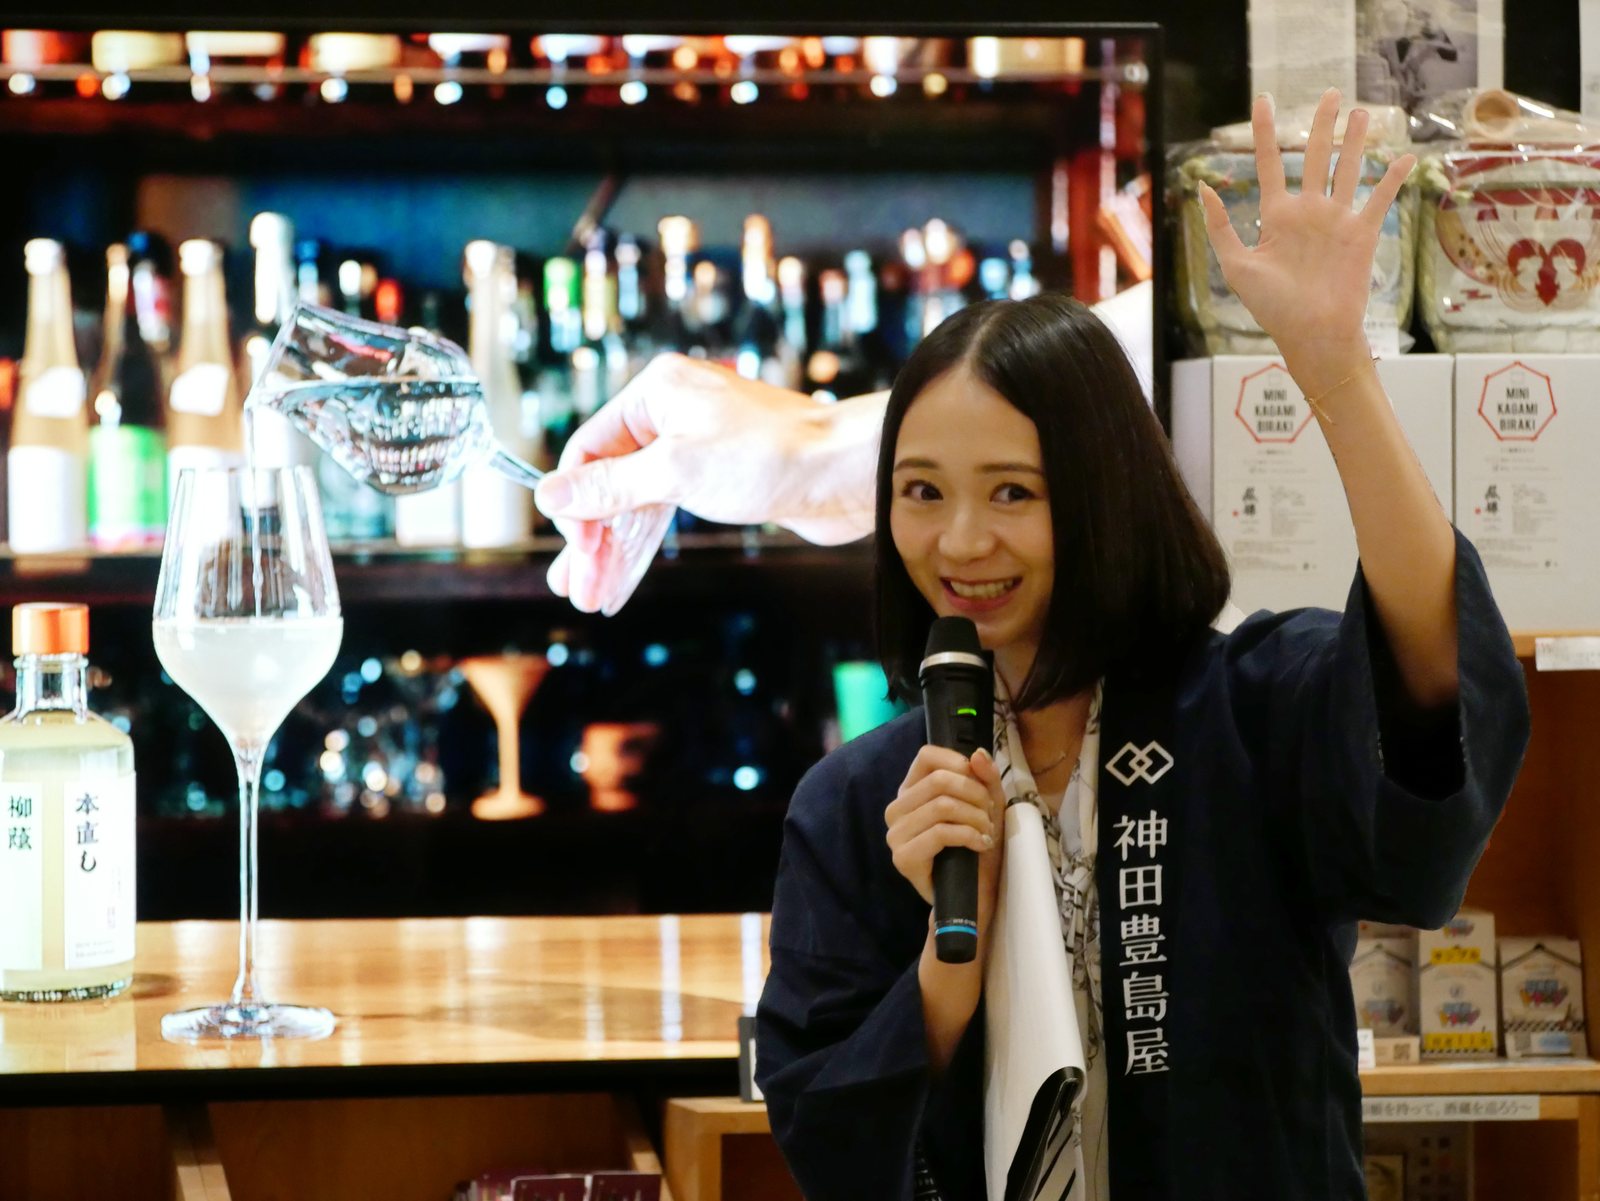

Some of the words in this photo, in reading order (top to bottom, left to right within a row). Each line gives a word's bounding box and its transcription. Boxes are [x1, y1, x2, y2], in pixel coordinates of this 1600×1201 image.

[1263, 389, 1287, 401] MINI
[1506, 387, 1529, 399] MINI
[1255, 405, 1297, 417] KAGAMI
[1497, 403, 1538, 415] KAGAMI
[1257, 421, 1294, 432] BIRAKI
[1500, 419, 1536, 431] BIRAKI
[75, 793, 99, 872] 本直し
[1112, 809, 1171, 1077] 神田豊島屋
